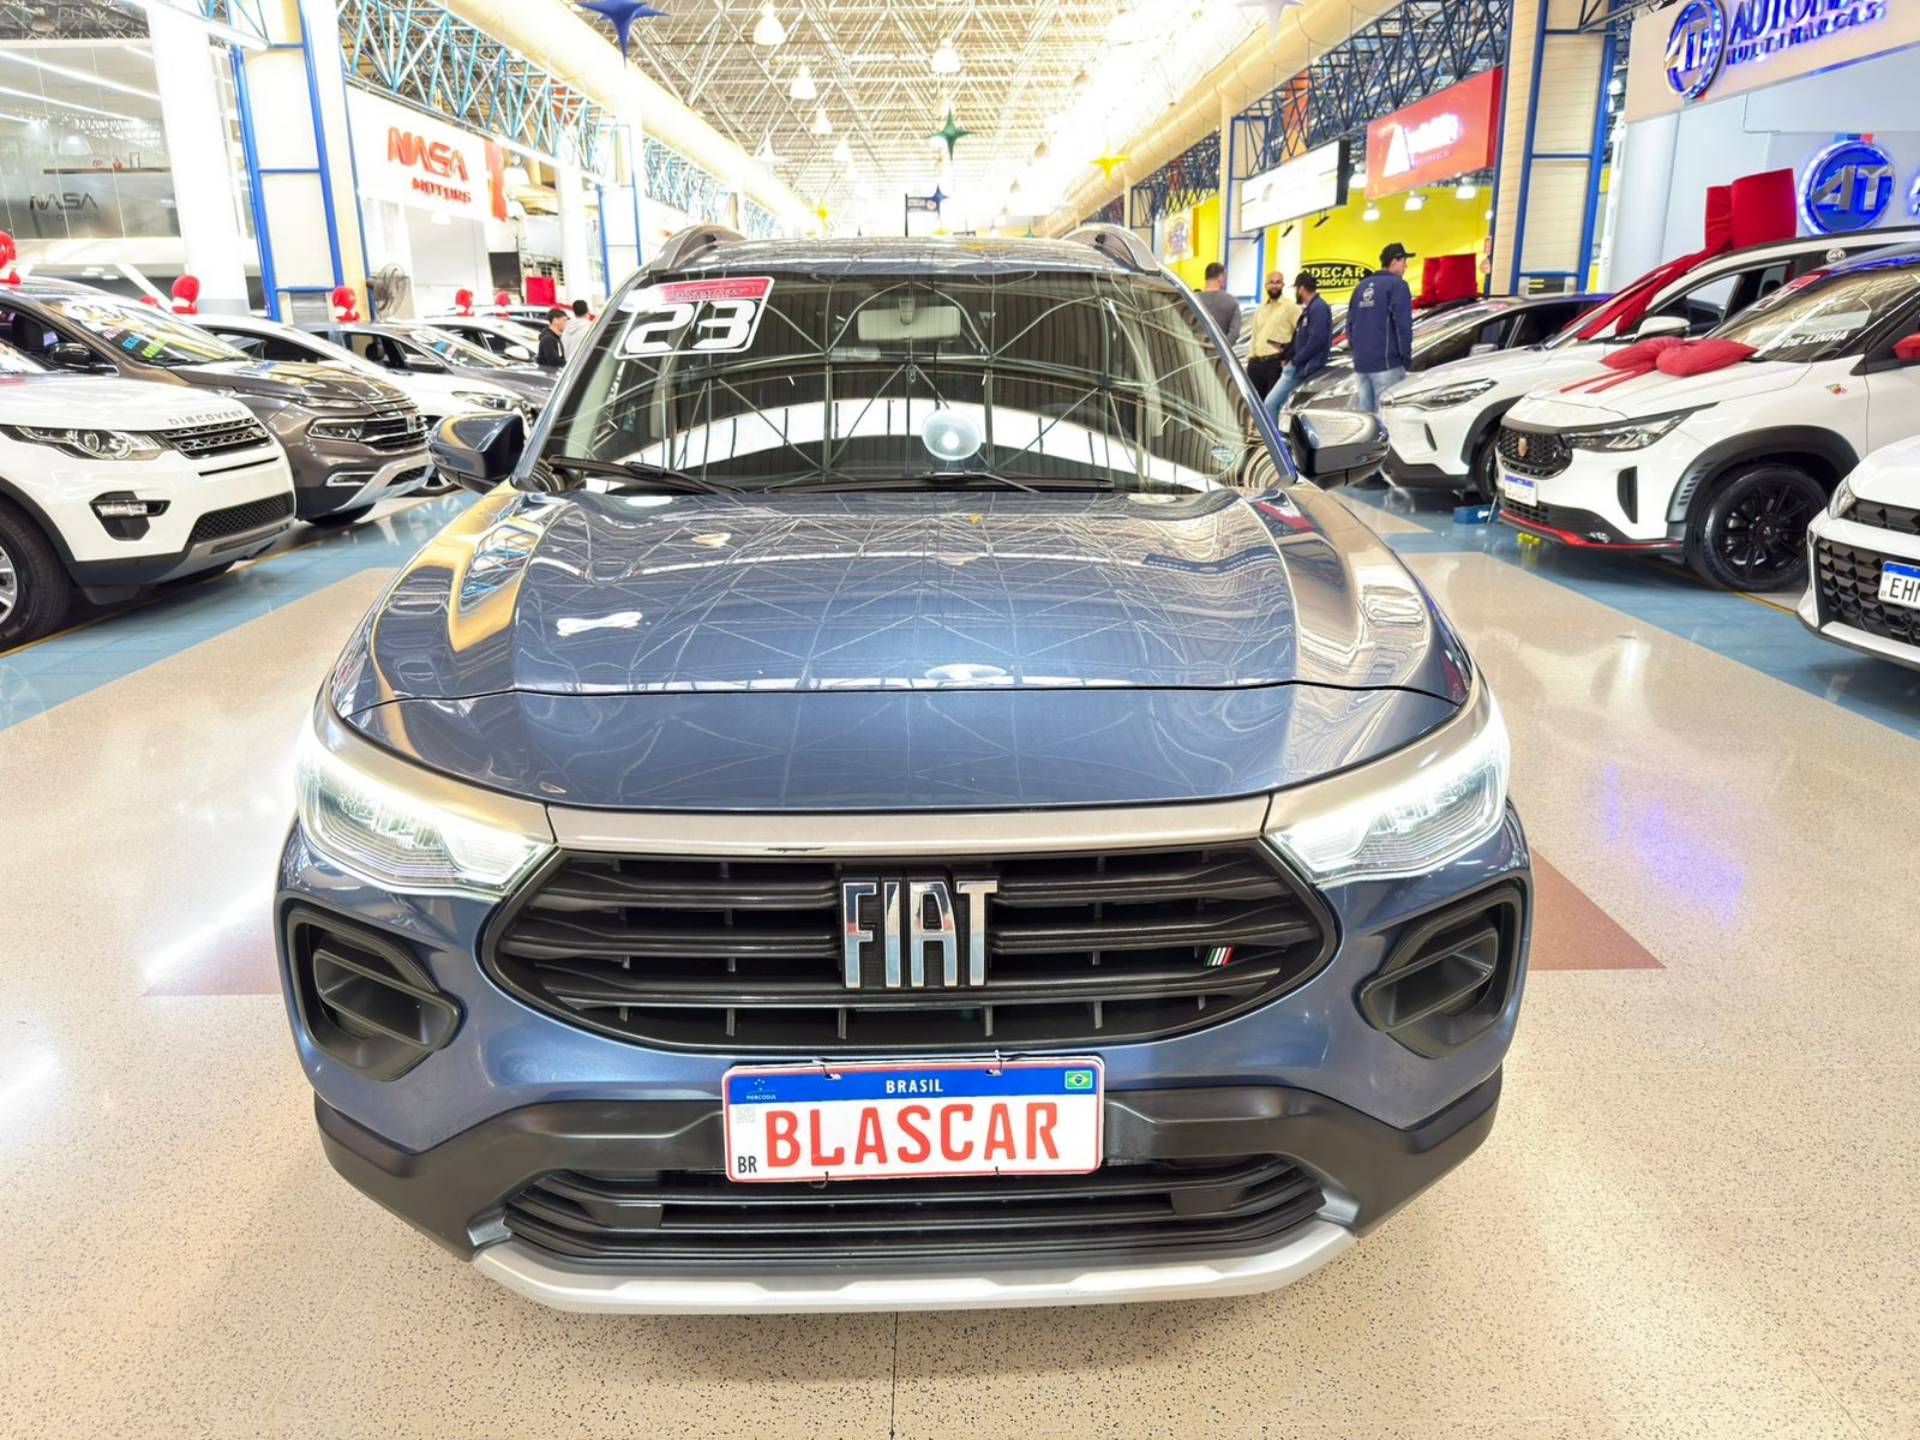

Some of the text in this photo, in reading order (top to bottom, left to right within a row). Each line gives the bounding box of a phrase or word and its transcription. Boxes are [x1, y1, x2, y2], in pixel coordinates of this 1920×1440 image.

[387, 126, 469, 182] NASA
[29, 192, 98, 211] NASA
[412, 177, 471, 204] MOTORS
[1812, 163, 1894, 212] AT
[620, 299, 757, 354] 23
[168, 409, 243, 426] DISCOVERY
[842, 880, 998, 988] FIAT
[885, 1079, 943, 1094] BRASIL
[766, 1102, 1059, 1168] BLASCAR
[737, 1155, 758, 1175] BR
